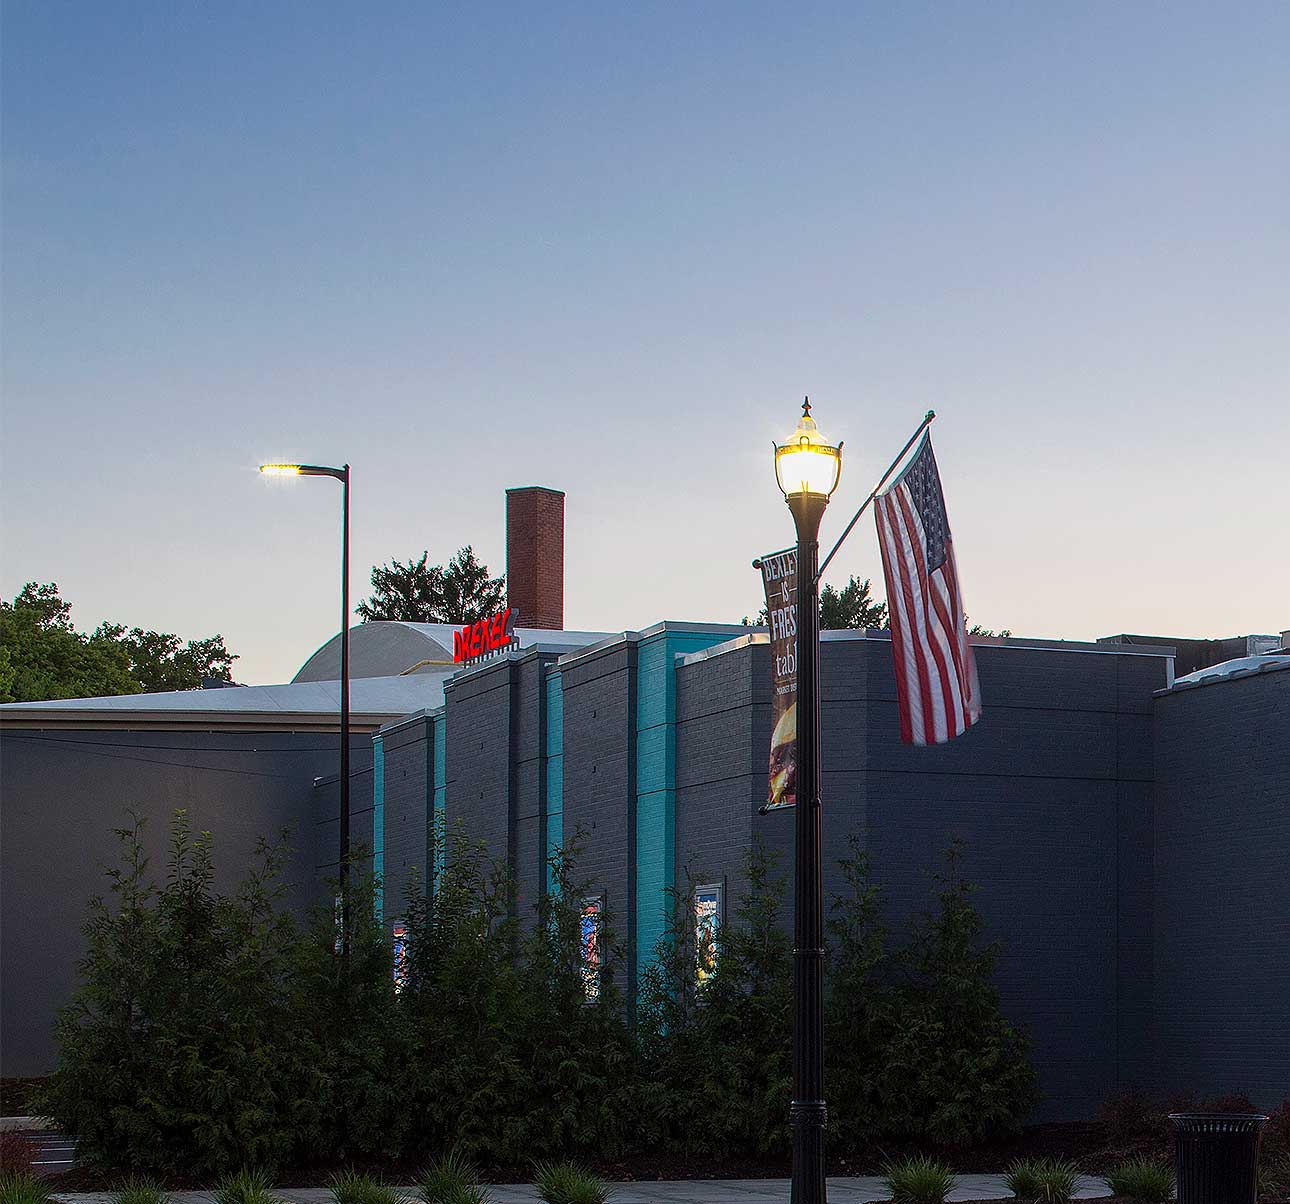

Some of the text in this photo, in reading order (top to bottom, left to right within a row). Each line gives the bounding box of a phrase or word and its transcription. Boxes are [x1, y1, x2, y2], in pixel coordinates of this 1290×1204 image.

[781, 581, 789, 603] IS
[453, 607, 512, 664] DREXEL
[771, 604, 798, 641] FRES
[776, 641, 797, 677] tabl
